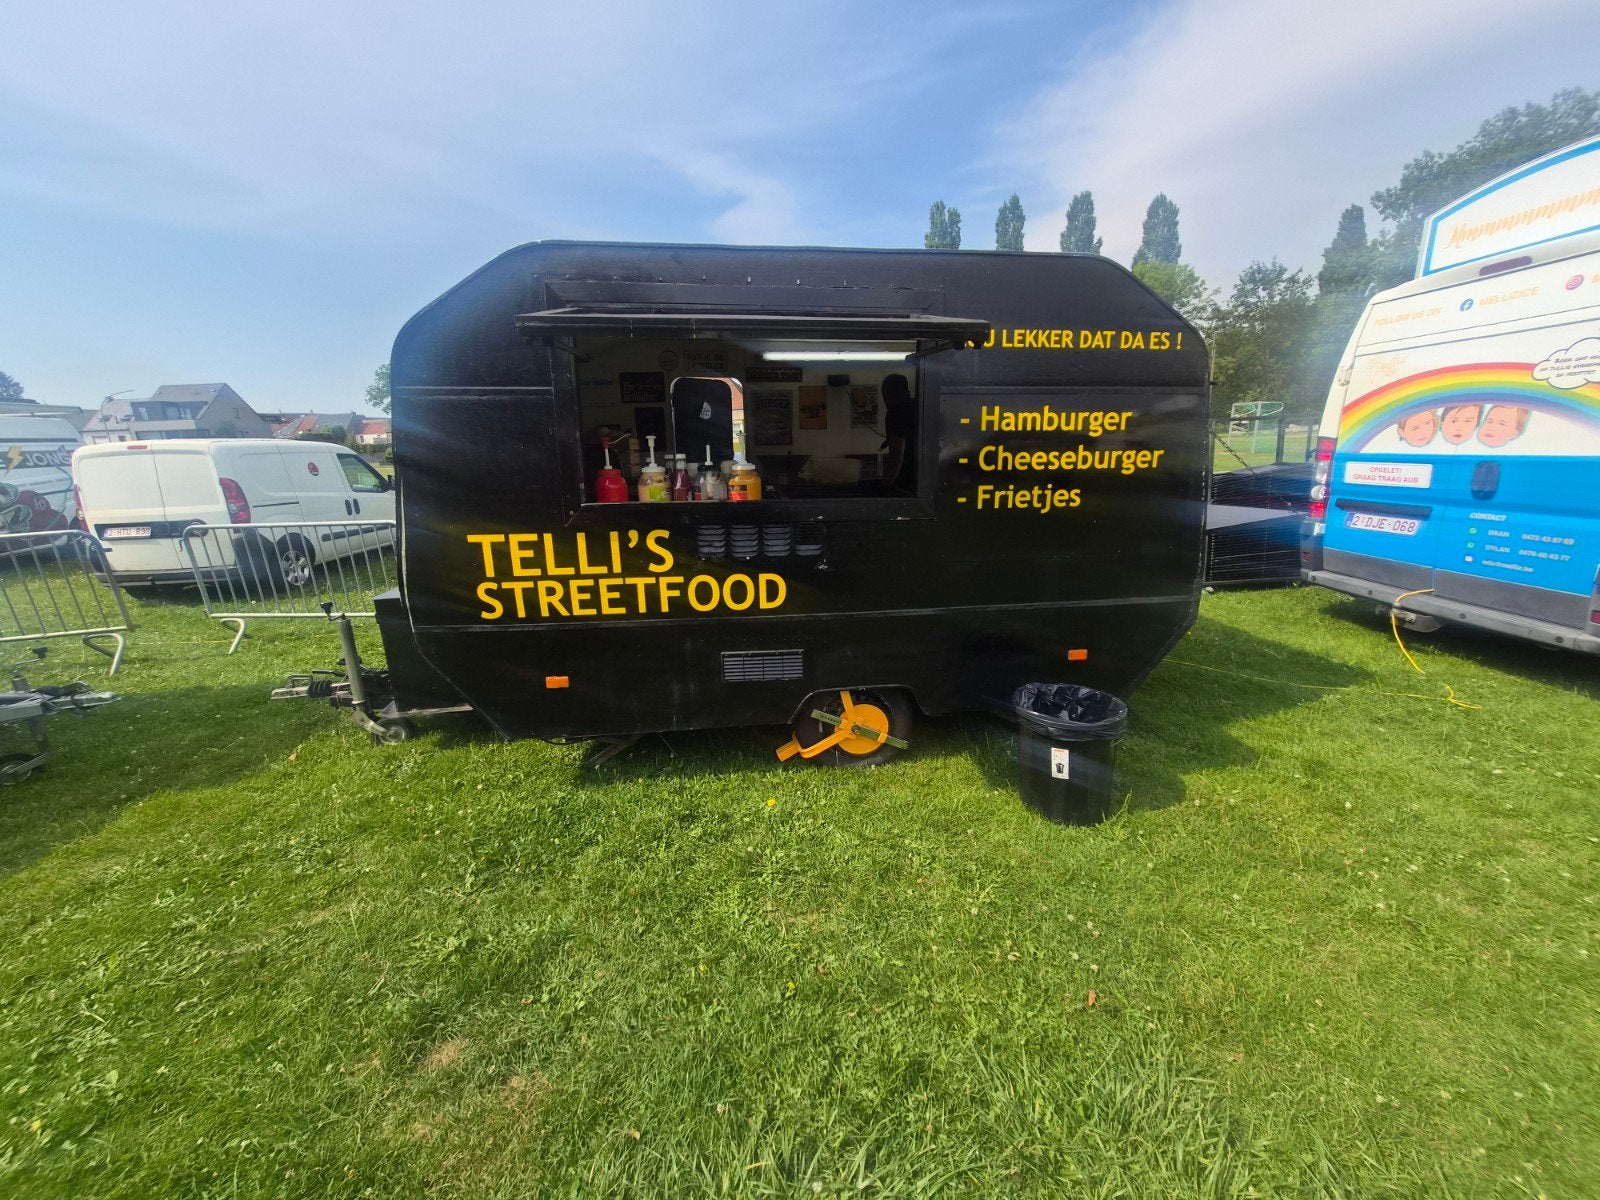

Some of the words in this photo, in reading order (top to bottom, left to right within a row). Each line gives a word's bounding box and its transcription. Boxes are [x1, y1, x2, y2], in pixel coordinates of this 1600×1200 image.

[1374, 313, 1410, 327] FOLLOW
[1410, 309, 1426, 321] US
[1426, 306, 1442, 317] ON
[1001, 328, 1074, 349] LEKKER
[1079, 329, 1117, 349] DAT
[1119, 330, 1145, 350] DA
[1148, 331, 1171, 350] ES
[980, 404, 1134, 438] Hamburger
[978, 444, 1165, 475] Cheeseburger
[1369, 466, 1402, 475] OPGELET!
[1352, 473, 1376, 481] GRAAG
[977, 483, 1081, 514] Frietjes
[1352, 514, 1417, 534] 2-DJE-068
[1469, 512, 1508, 522] CONTACT
[466, 529, 676, 578] TELLI'S
[476, 573, 787, 620] STREETFOOD
